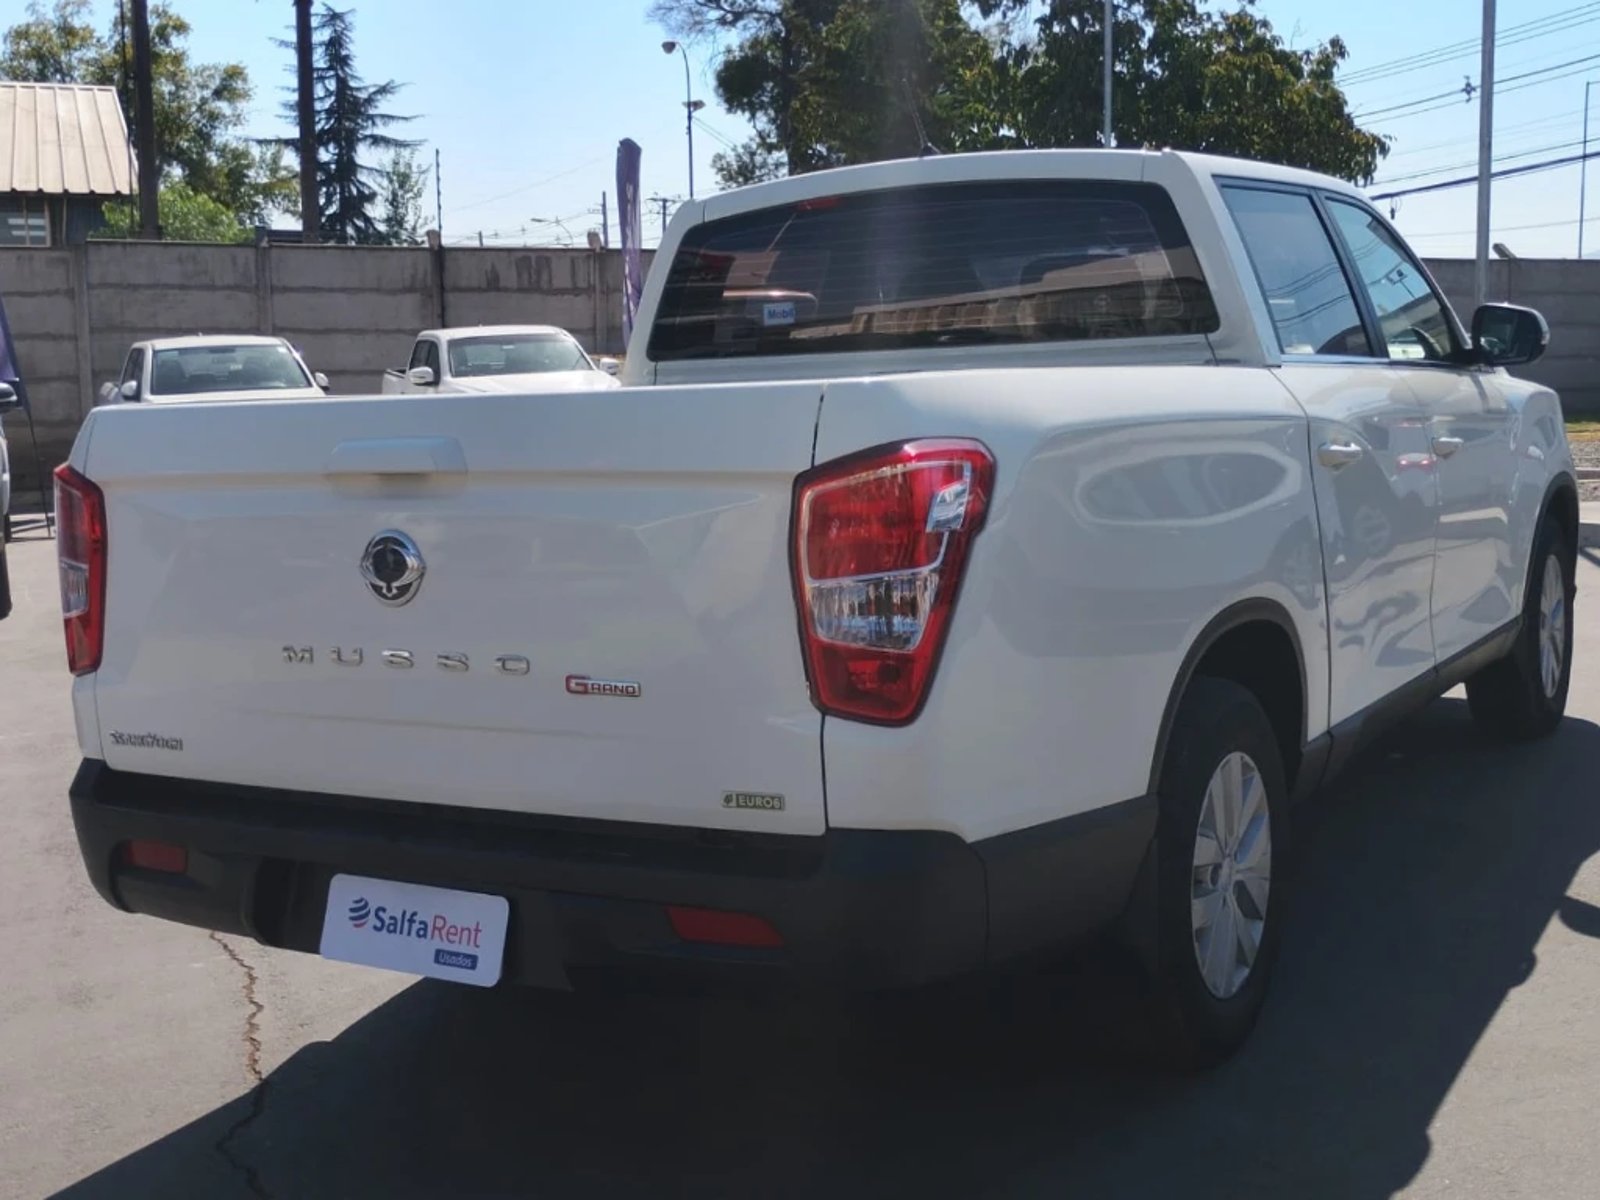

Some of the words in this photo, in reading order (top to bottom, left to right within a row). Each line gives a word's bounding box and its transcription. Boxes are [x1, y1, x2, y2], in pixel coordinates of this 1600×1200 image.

[282, 645, 531, 675] MUSSO
[565, 674, 641, 697] GRAND
[738, 795, 781, 809] EURO6
[372, 906, 482, 948] SalfaRent
[438, 951, 472, 967] Usados
